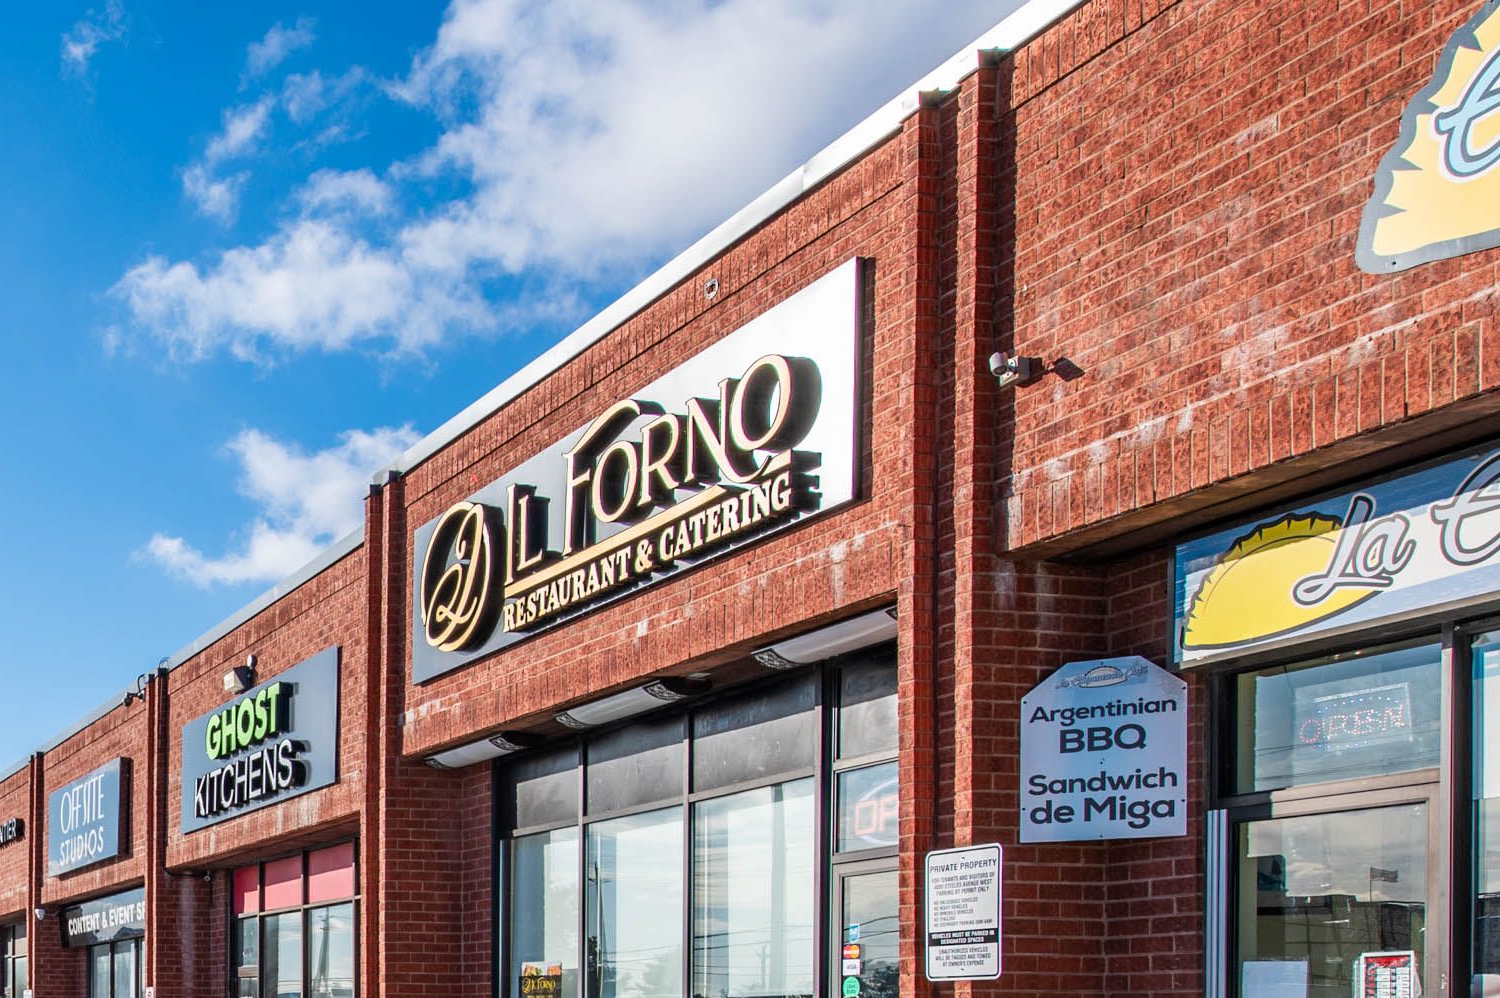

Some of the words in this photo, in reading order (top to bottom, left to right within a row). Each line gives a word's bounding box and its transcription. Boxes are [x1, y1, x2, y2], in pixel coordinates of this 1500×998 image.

[561, 354, 791, 557] FORNO
[502, 546, 631, 633] RESTAURANT
[634, 539, 653, 574] &
[659, 470, 792, 562] CATERING
[1292, 495, 1417, 606] La
[206, 681, 280, 761] GHOST
[1029, 697, 1177, 727] Argentinian
[1300, 704, 1405, 743] OPEN
[1059, 723, 1147, 754] BBQ
[194, 738, 293, 818] KITCHENS
[1028, 766, 1178, 796] Sandwich
[60, 774, 105, 834] OFFSITE
[1030, 799, 1075, 825] de
[1083, 795, 1176, 830] Miga
[59, 826, 105, 867] STUDIOS
[930, 863, 958, 873] PRIVATE
[960, 859, 997, 870] PROPERTY
[969, 872, 988, 880] VISITORS
[68, 911, 100, 936] CONTENT
[101, 911, 108, 928] &
[109, 904, 136, 927] EVENT
